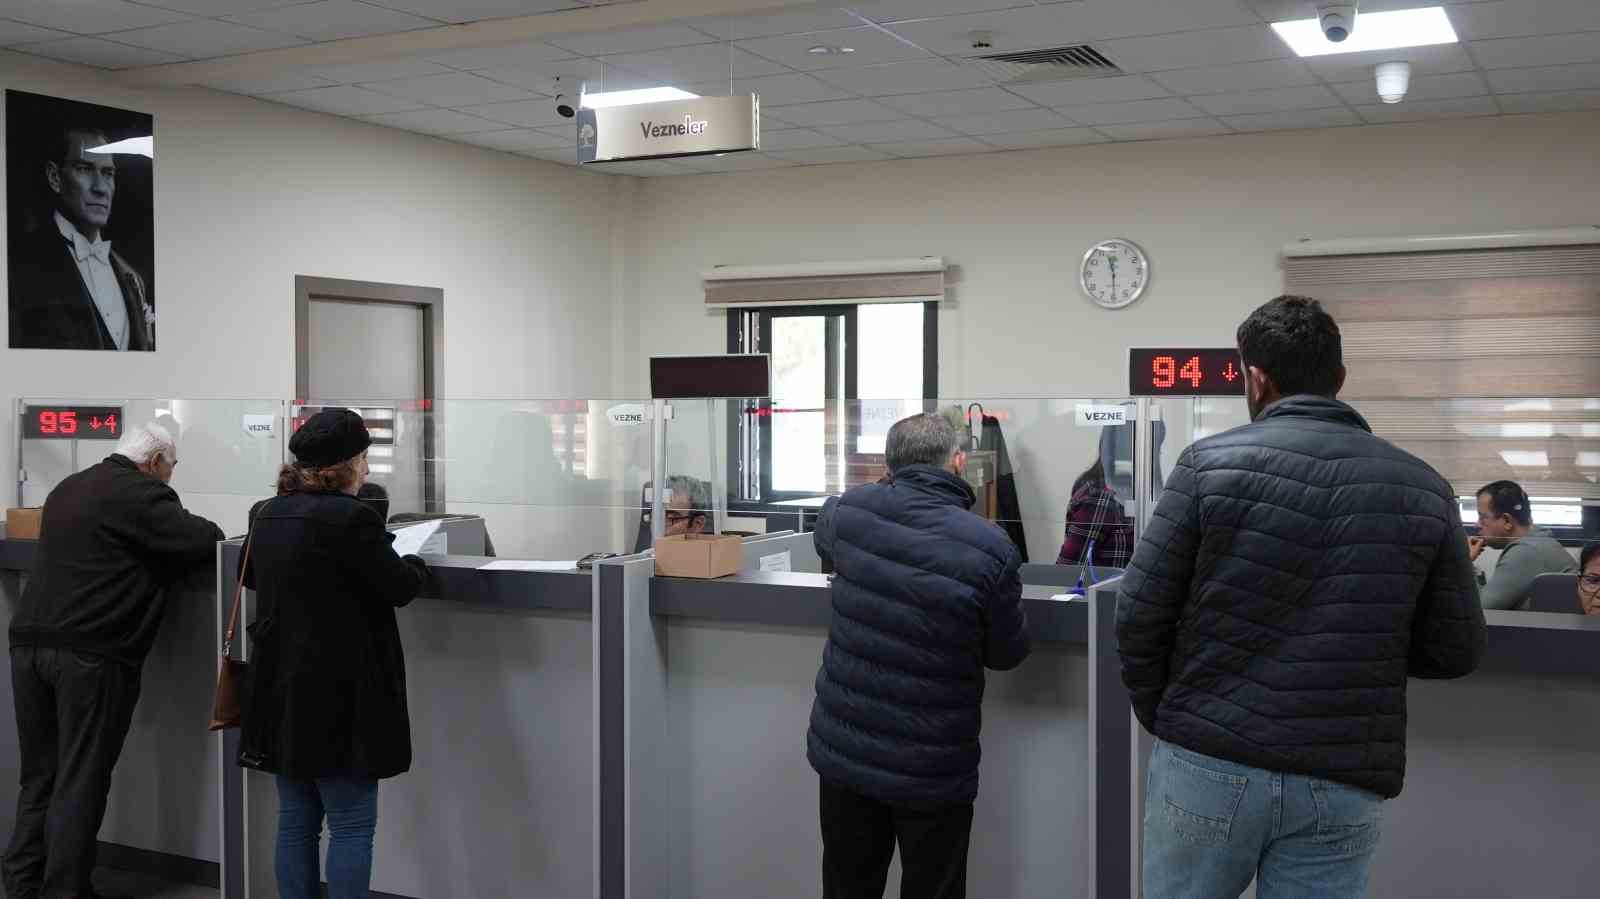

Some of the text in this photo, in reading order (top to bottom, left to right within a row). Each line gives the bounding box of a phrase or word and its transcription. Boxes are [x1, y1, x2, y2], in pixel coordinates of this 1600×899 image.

[640, 114, 708, 139] Vezneler
[1153, 356, 1202, 387] 94
[39, 411, 117, 434] 95 4
[614, 413, 642, 422] VEZNE
[1085, 411, 1122, 421] VEZNE
